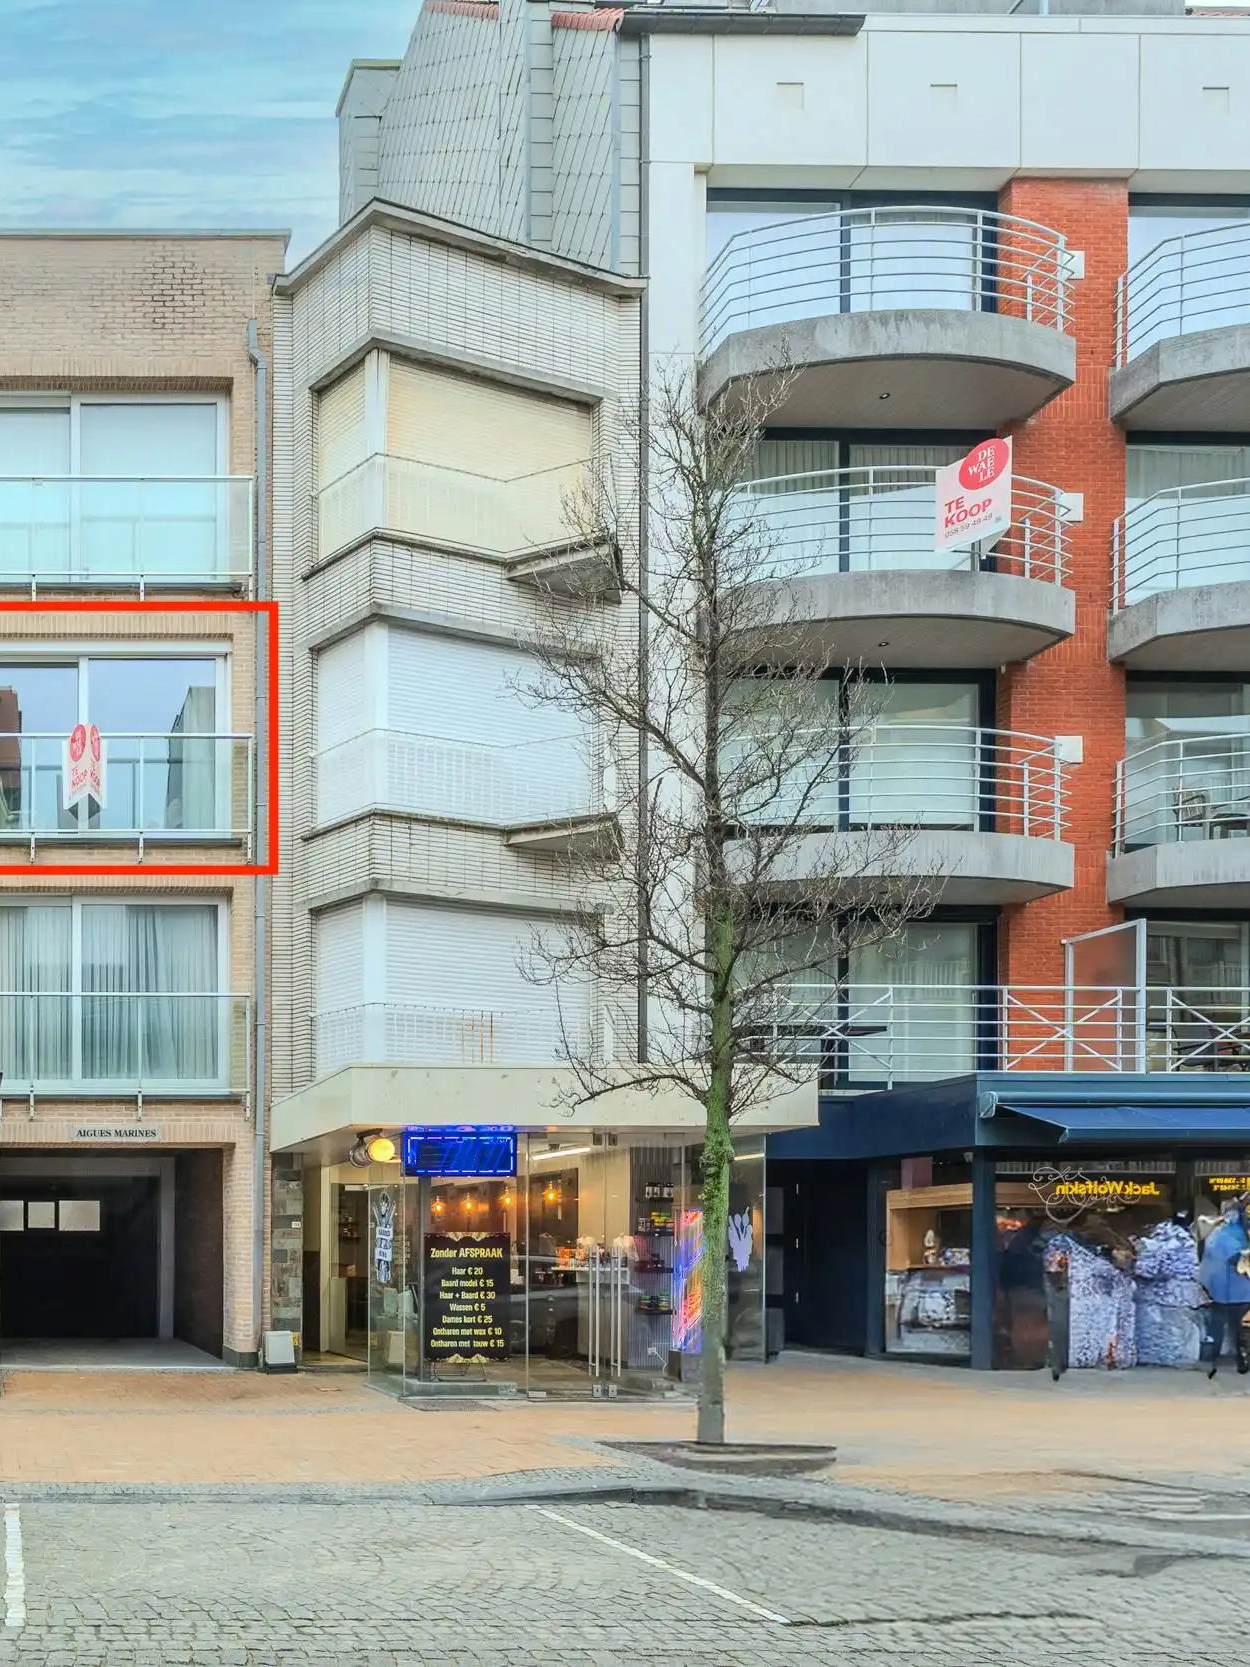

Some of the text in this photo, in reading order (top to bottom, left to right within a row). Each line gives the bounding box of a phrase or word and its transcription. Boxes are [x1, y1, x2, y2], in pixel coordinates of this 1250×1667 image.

[978, 445, 996, 461] DE
[967, 456, 995, 477] WAE
[978, 468, 995, 483] LE
[944, 496, 965, 514] TE
[944, 498, 993, 529] KOOP
[76, 1129, 157, 1138] AIGUES MARINES
[430, 1248, 503, 1258] Zonder AFSPRAAK
[452, 1267, 483, 1275] Haar € 20
[441, 1279, 459, 1287] Baard
[460, 1279, 478, 1287] model
[439, 1291, 454, 1299] Haar
[461, 1291, 479, 1299] Baard
[480, 1291, 485, 1299] €
[486, 1291, 496, 1299] 30
[449, 1303, 486, 1311] Wassen € 5
[442, 1315, 493, 1323] Dames kort € 25
[432, 1327, 460, 1335] Ontharen
[487, 1327, 493, 1335] €
[494, 1327, 503, 1335] 10
[430, 1339, 458, 1347] Ontharen
